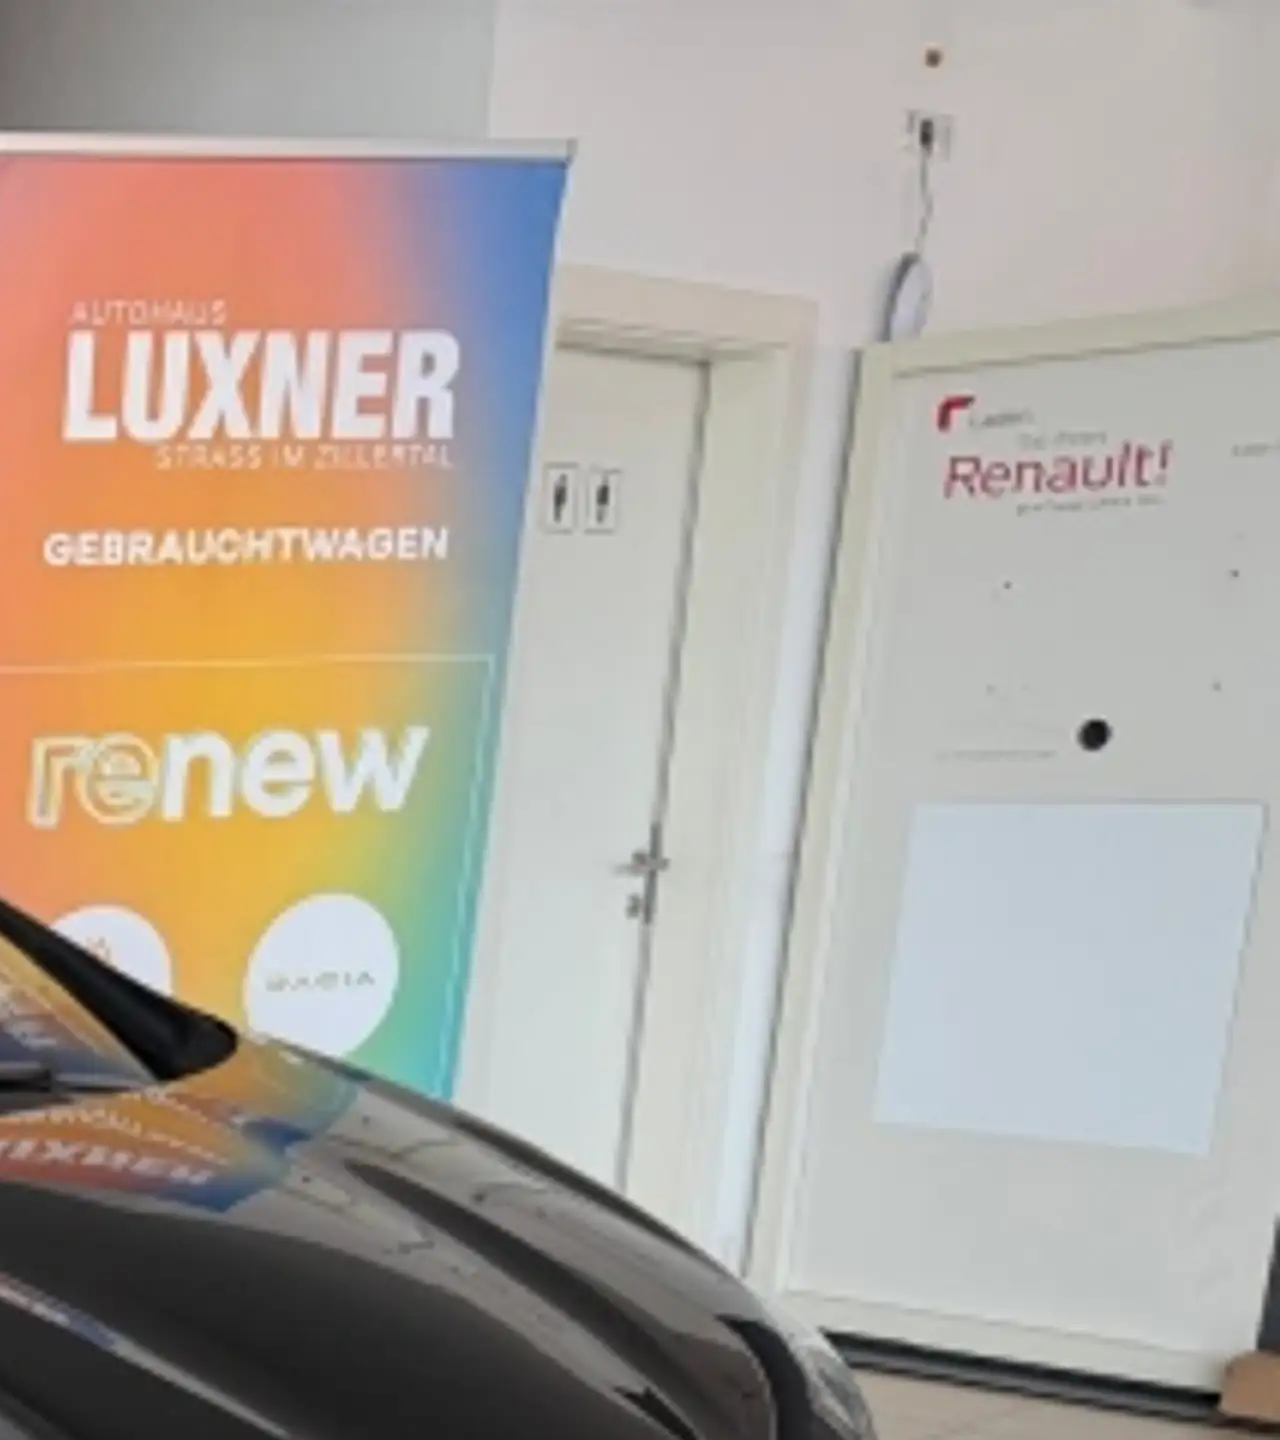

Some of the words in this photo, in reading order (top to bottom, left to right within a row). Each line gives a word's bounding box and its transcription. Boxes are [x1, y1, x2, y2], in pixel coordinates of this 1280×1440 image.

[70, 300, 227, 326] AUTOHAUS
[64, 329, 460, 442] LUXNER
[155, 444, 262, 471] STRASS
[273, 445, 304, 470] IM
[314, 443, 454, 470] ZILLERTAL
[943, 438, 1174, 501] Renault!
[43, 527, 450, 567] GEBRAUCHTWAGEN
[26, 724, 431, 828] renew
